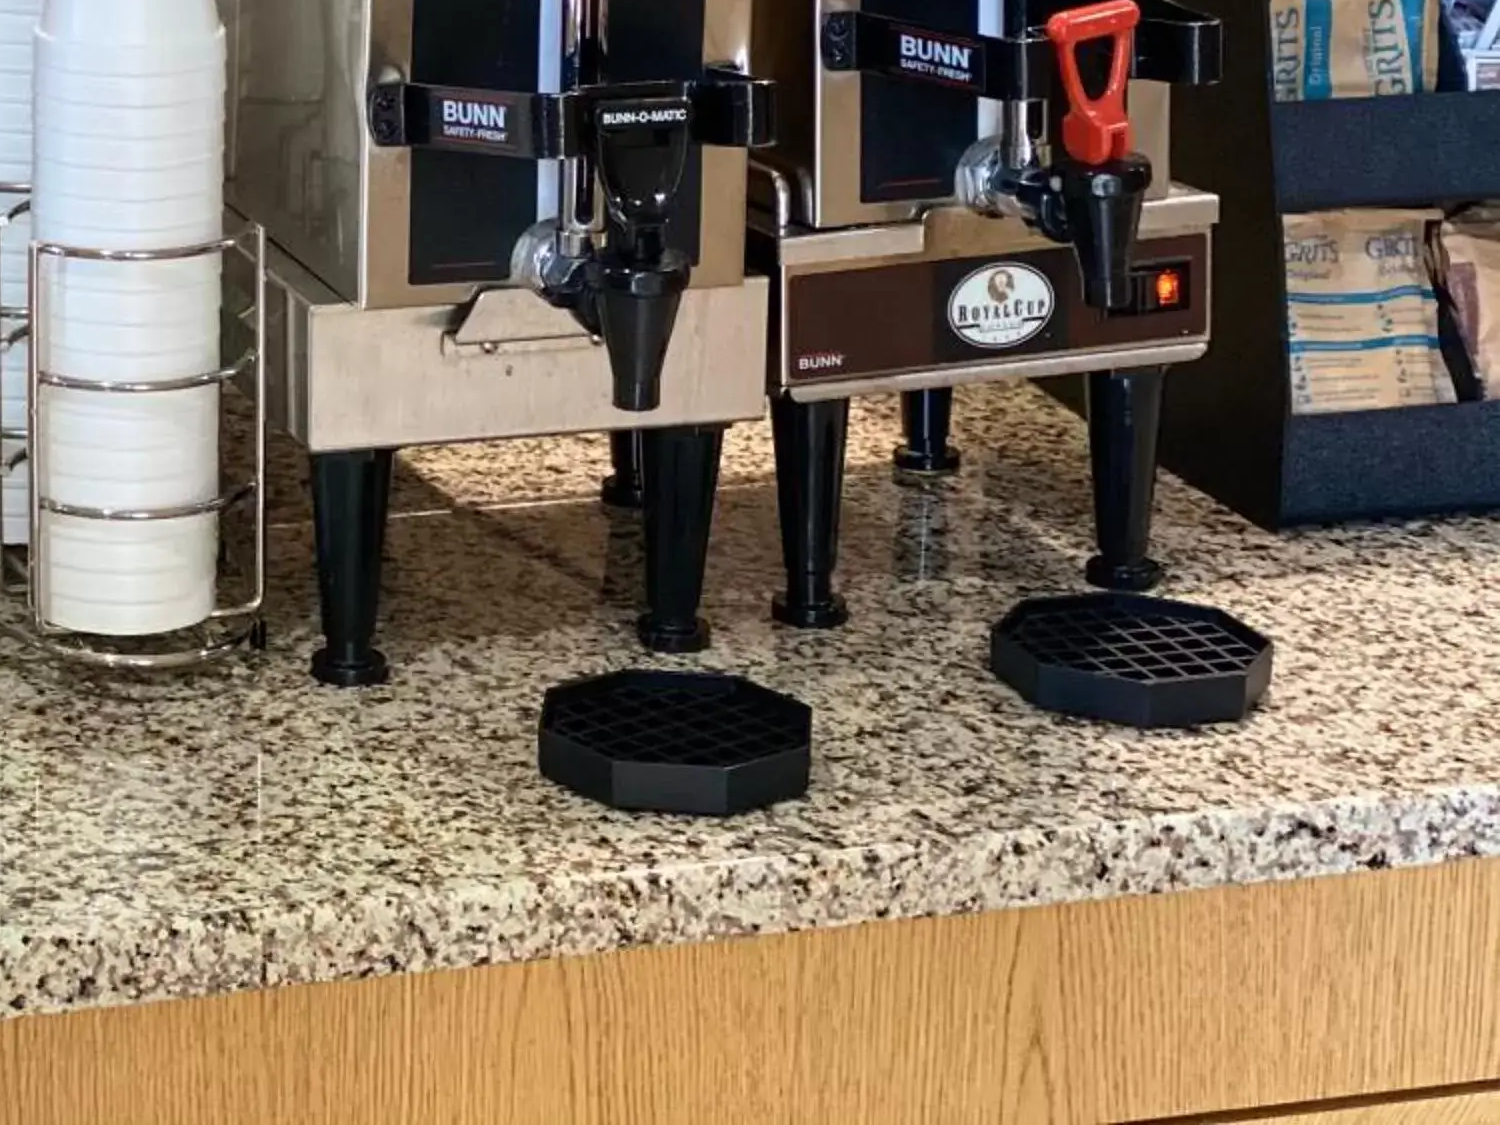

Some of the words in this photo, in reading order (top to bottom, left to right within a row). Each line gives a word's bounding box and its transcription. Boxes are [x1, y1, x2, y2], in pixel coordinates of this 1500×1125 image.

[900, 35, 970, 69] BUNN
[442, 101, 507, 129] BUNN
[602, 109, 687, 125] BUNN-O-MATIC
[798, 354, 843, 371] BUNN
